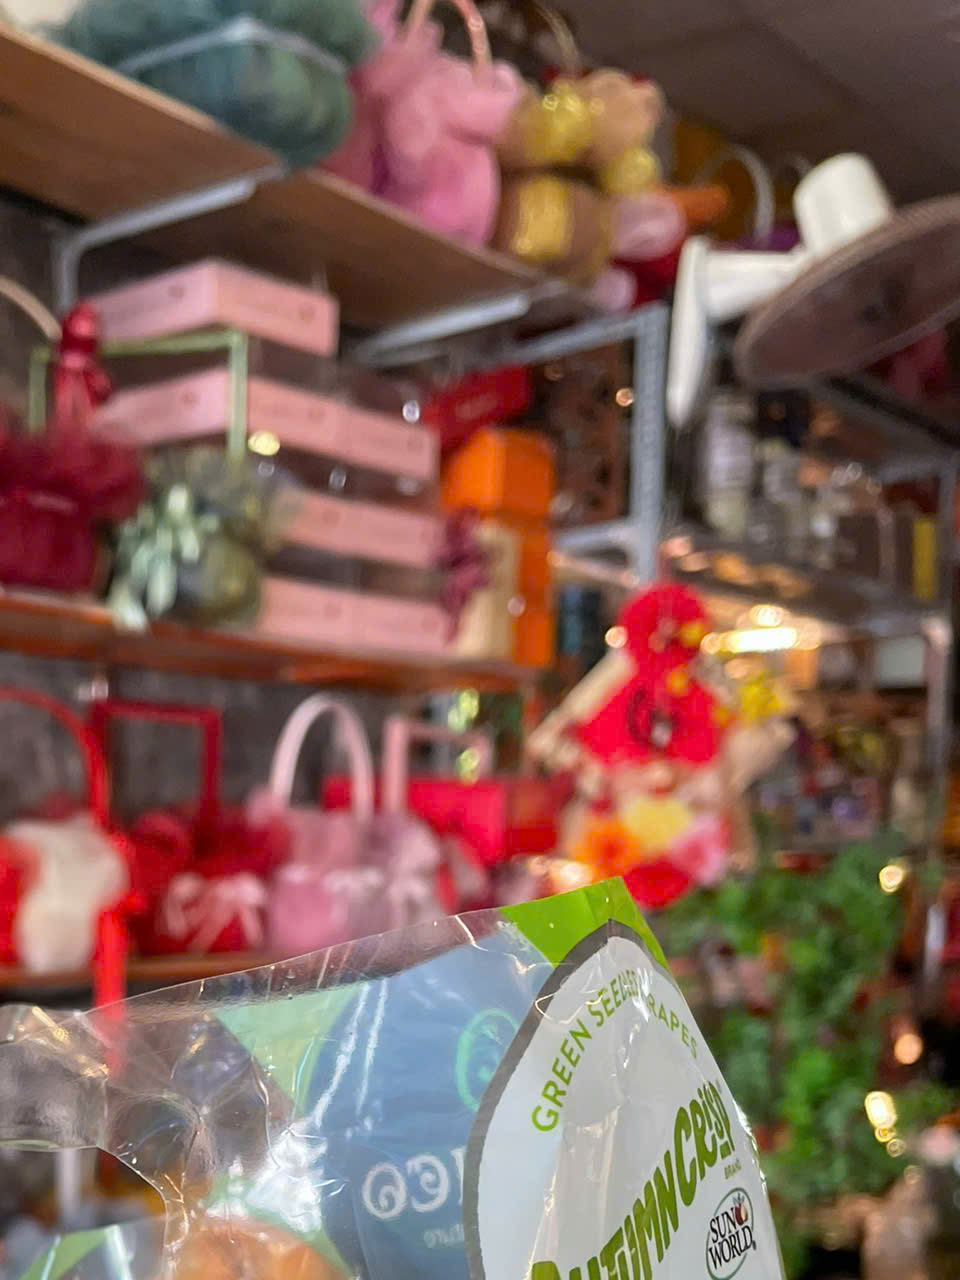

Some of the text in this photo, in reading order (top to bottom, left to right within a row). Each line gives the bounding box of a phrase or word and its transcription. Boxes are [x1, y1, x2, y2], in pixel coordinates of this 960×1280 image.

[531, 1018, 592, 1132] GREEN
[642, 988, 698, 1059] RAPES
[709, 1205, 738, 1244] SUN
